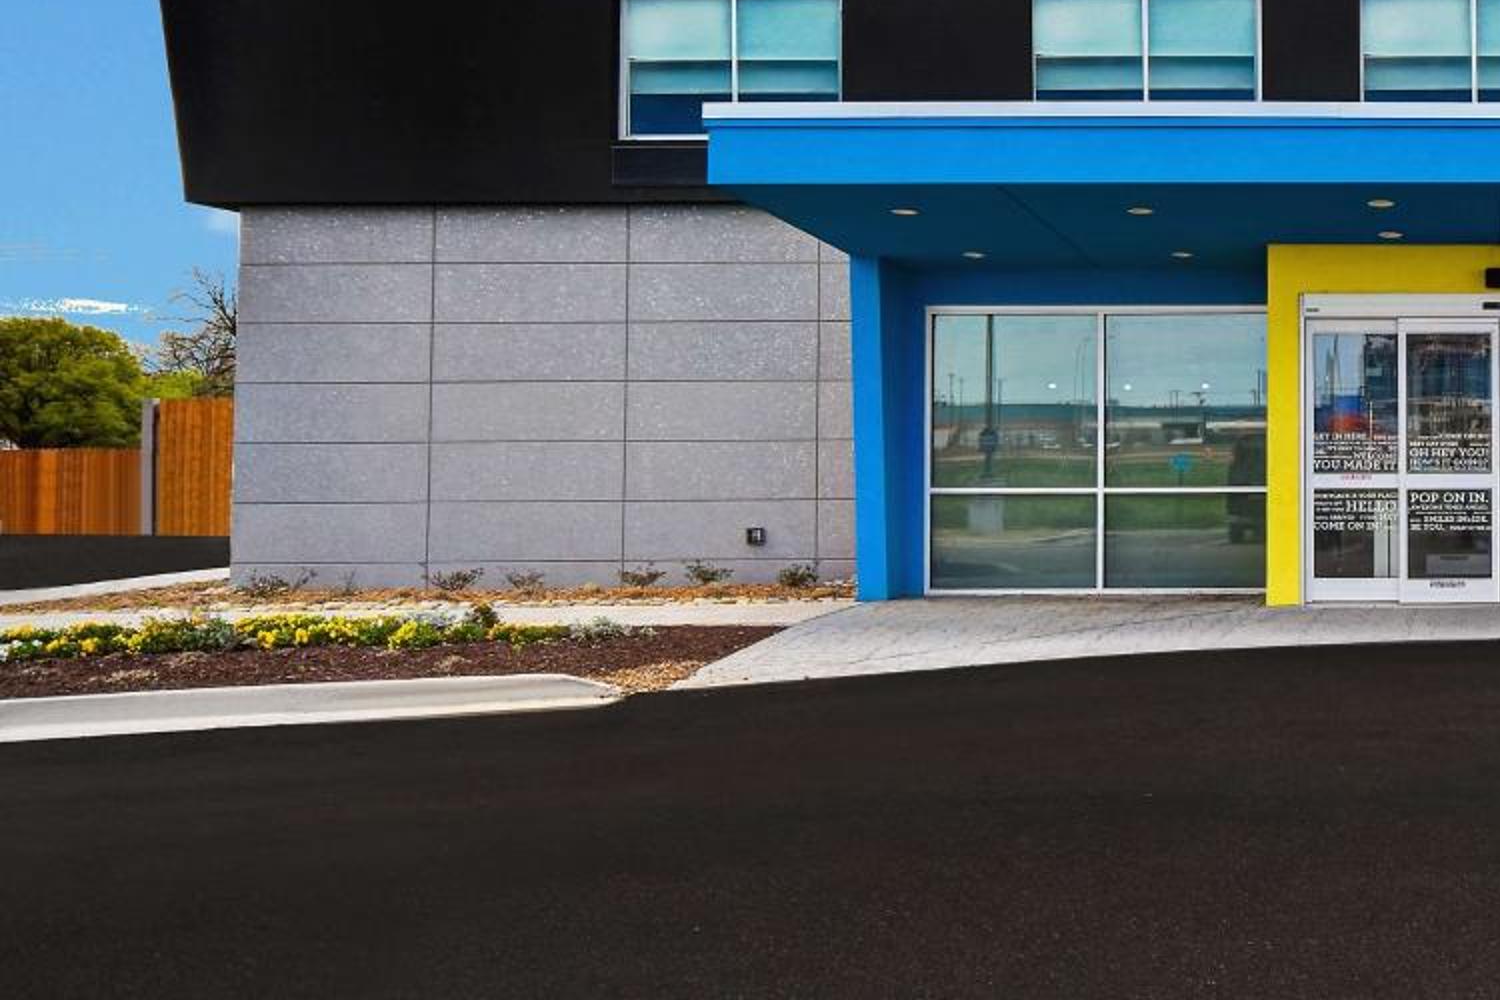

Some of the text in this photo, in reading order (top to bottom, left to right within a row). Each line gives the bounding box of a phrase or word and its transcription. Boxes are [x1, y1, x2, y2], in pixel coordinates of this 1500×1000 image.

[1313, 459, 1340, 471] YOU
[1343, 459, 1381, 471] MADE
[1410, 491, 1489, 503] POP ON IN.
[1346, 500, 1397, 513] HELLO
[1313, 521, 1345, 531] COME
[1347, 521, 1365, 531] ON
